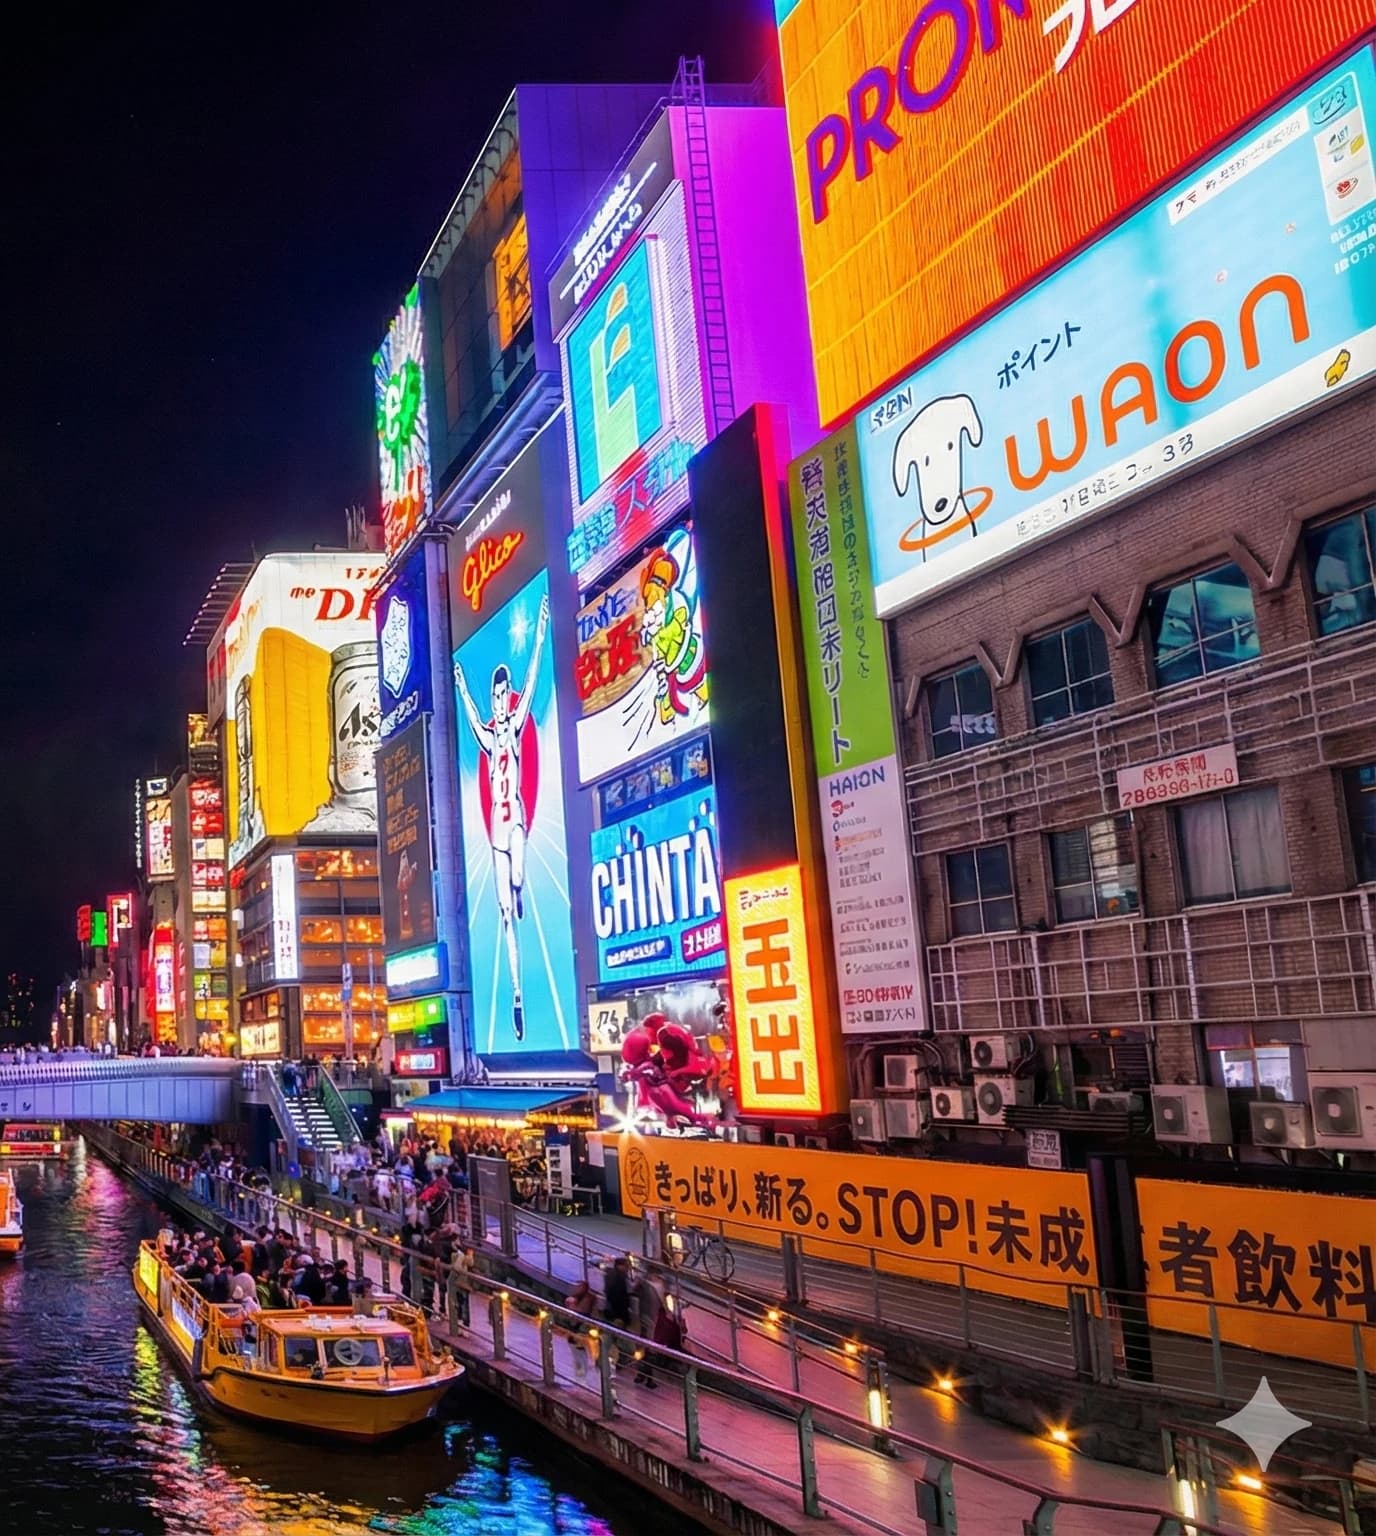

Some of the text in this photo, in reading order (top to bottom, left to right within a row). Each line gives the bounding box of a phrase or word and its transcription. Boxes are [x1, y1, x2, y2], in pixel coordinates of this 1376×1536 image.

[997, 321, 1082, 390] ポイント
[1138, 1220, 1376, 1325] 者飲料
